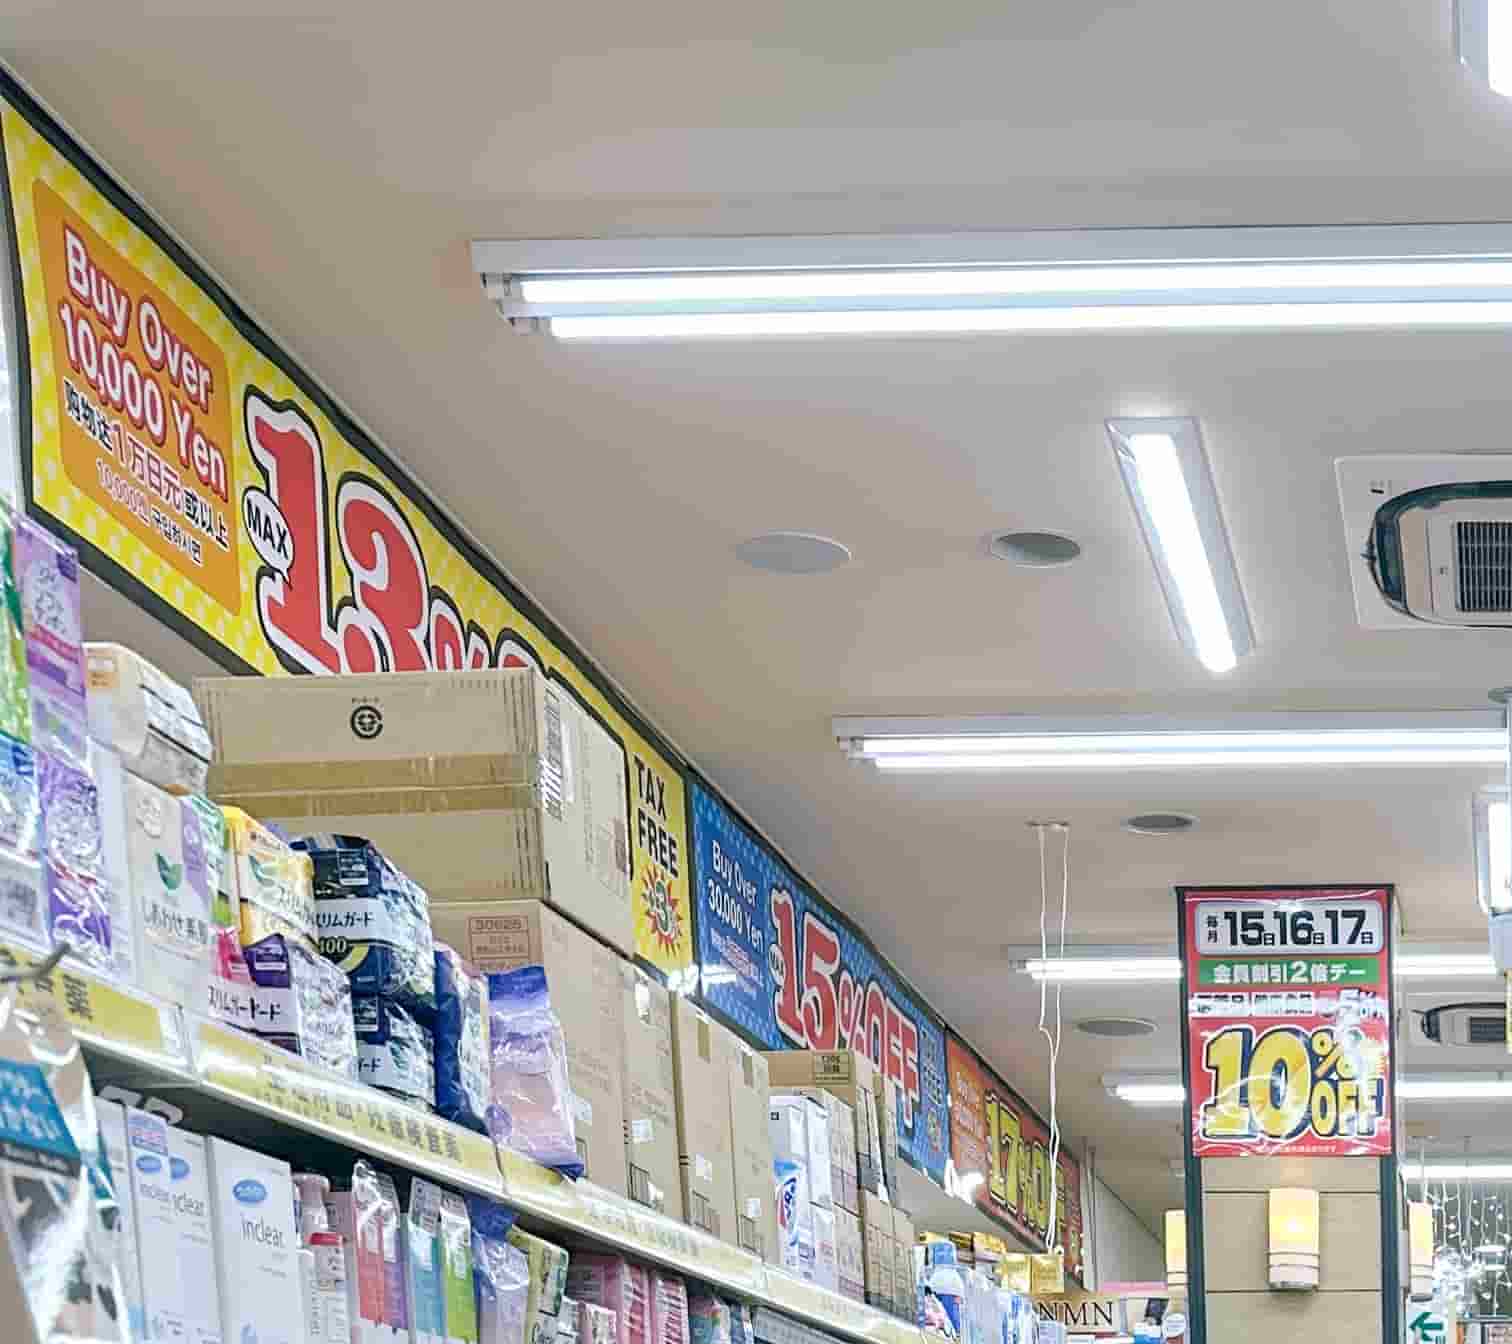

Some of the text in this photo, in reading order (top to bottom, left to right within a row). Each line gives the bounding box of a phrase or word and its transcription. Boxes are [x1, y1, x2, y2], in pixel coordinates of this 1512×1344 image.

[64, 225, 213, 414] Buy Over
[59, 301, 228, 503] 10,000 Yen
[246, 498, 289, 559] MAX
[633, 755, 666, 820] TAX
[638, 807, 679, 878] FREE
[711, 840, 757, 907] Buy Over
[743, 914, 764, 953] Yen
[771, 889, 841, 1051] 15
[1038, 1301, 1114, 1328] NMN
